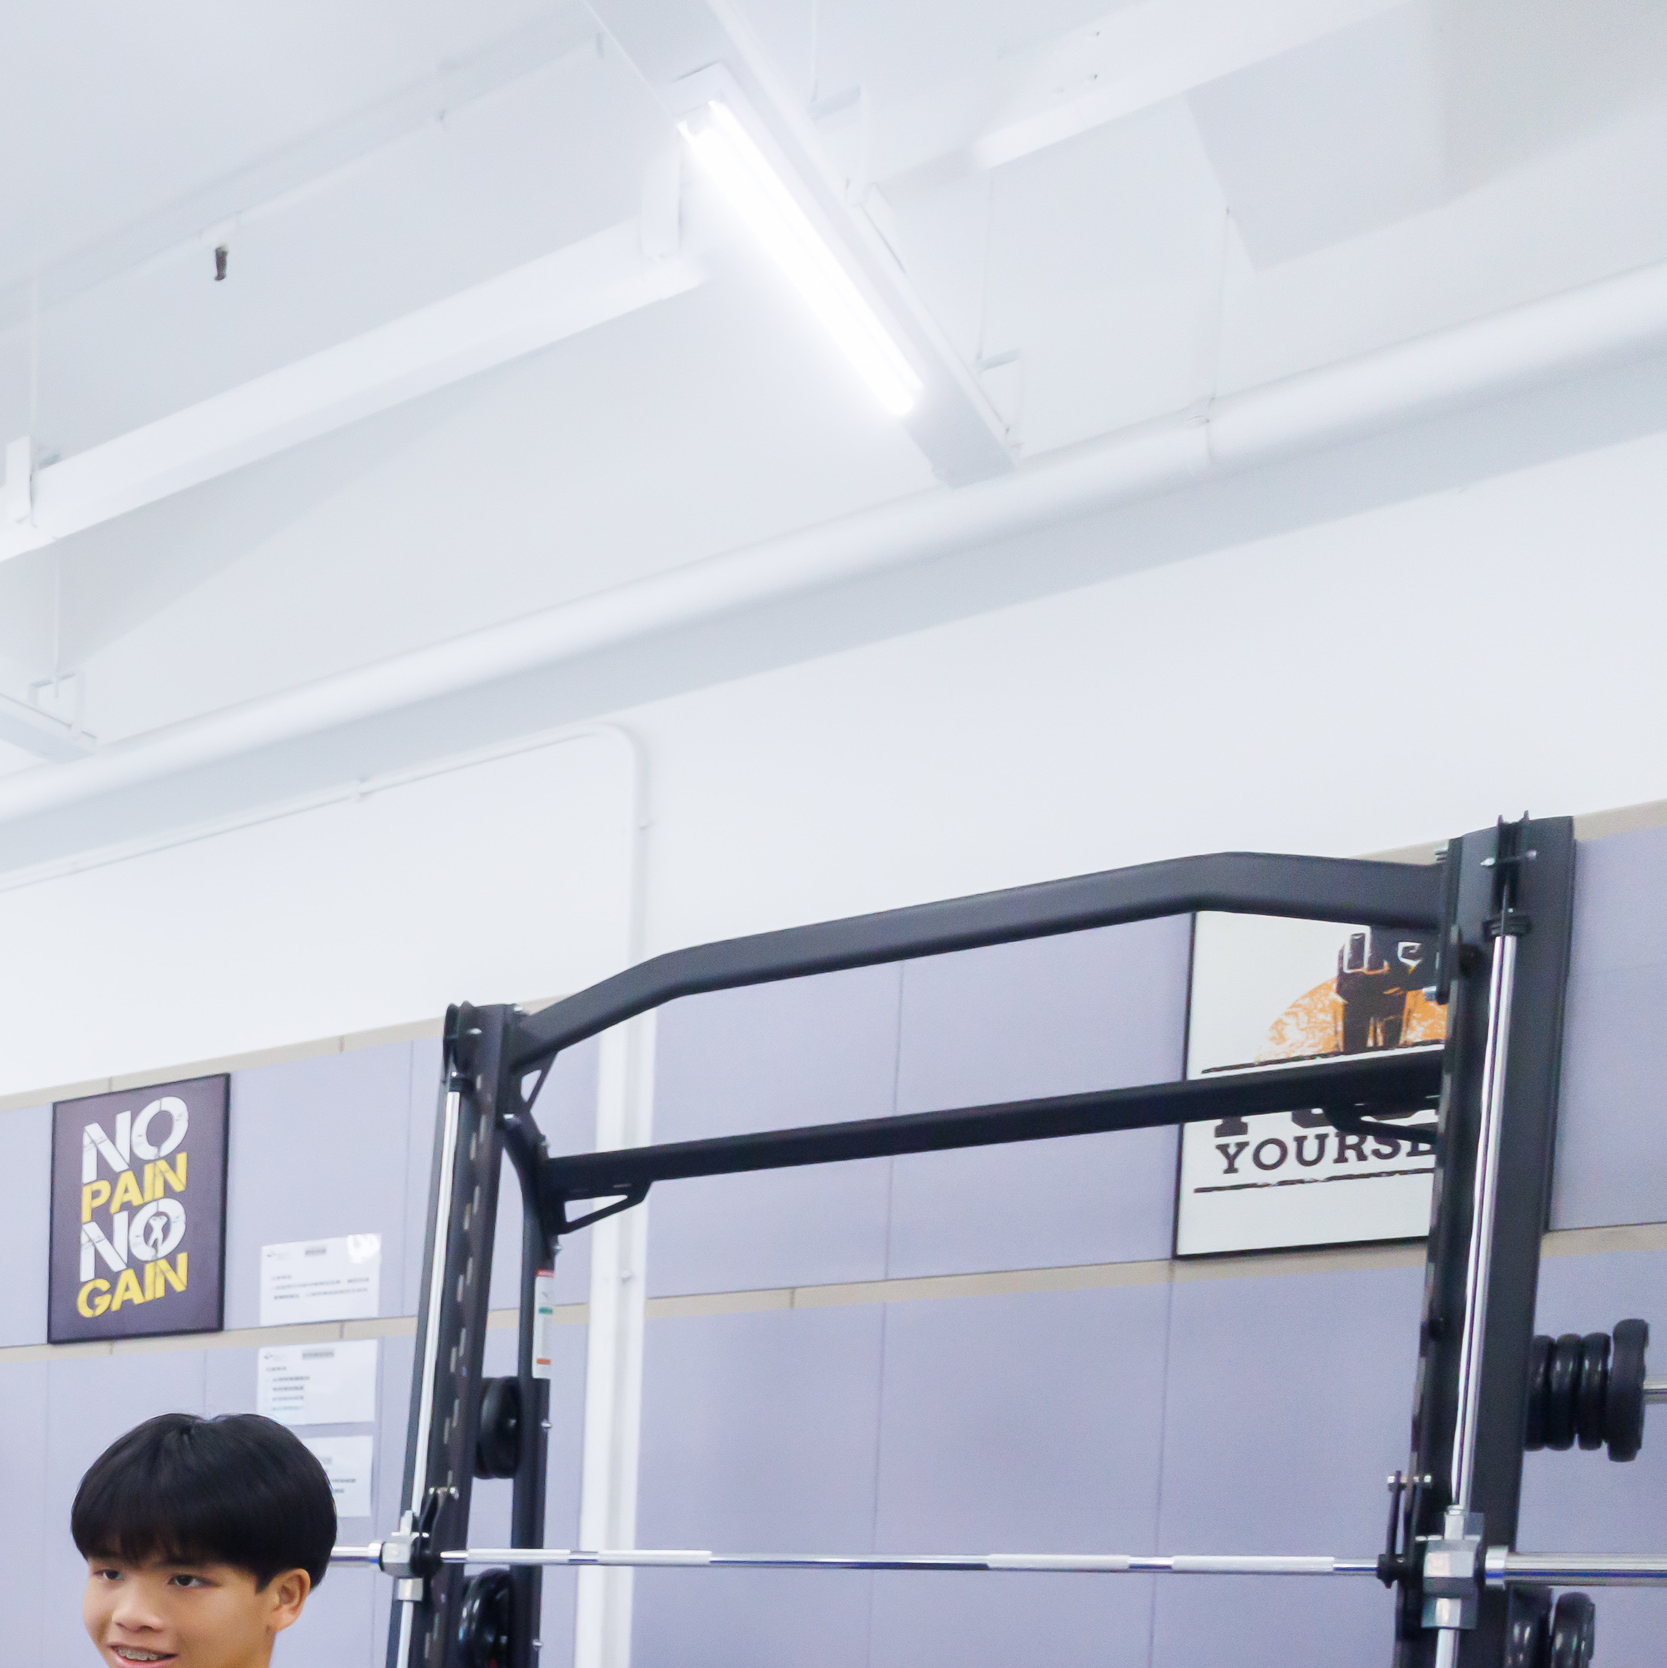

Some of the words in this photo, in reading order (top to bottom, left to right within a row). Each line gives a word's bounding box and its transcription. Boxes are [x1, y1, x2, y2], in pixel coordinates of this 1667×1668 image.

[81, 1095, 190, 1183] NO
[80, 1151, 188, 1223] PAIN
[79, 1197, 187, 1283] NO
[76, 1252, 189, 1319] GAIN
